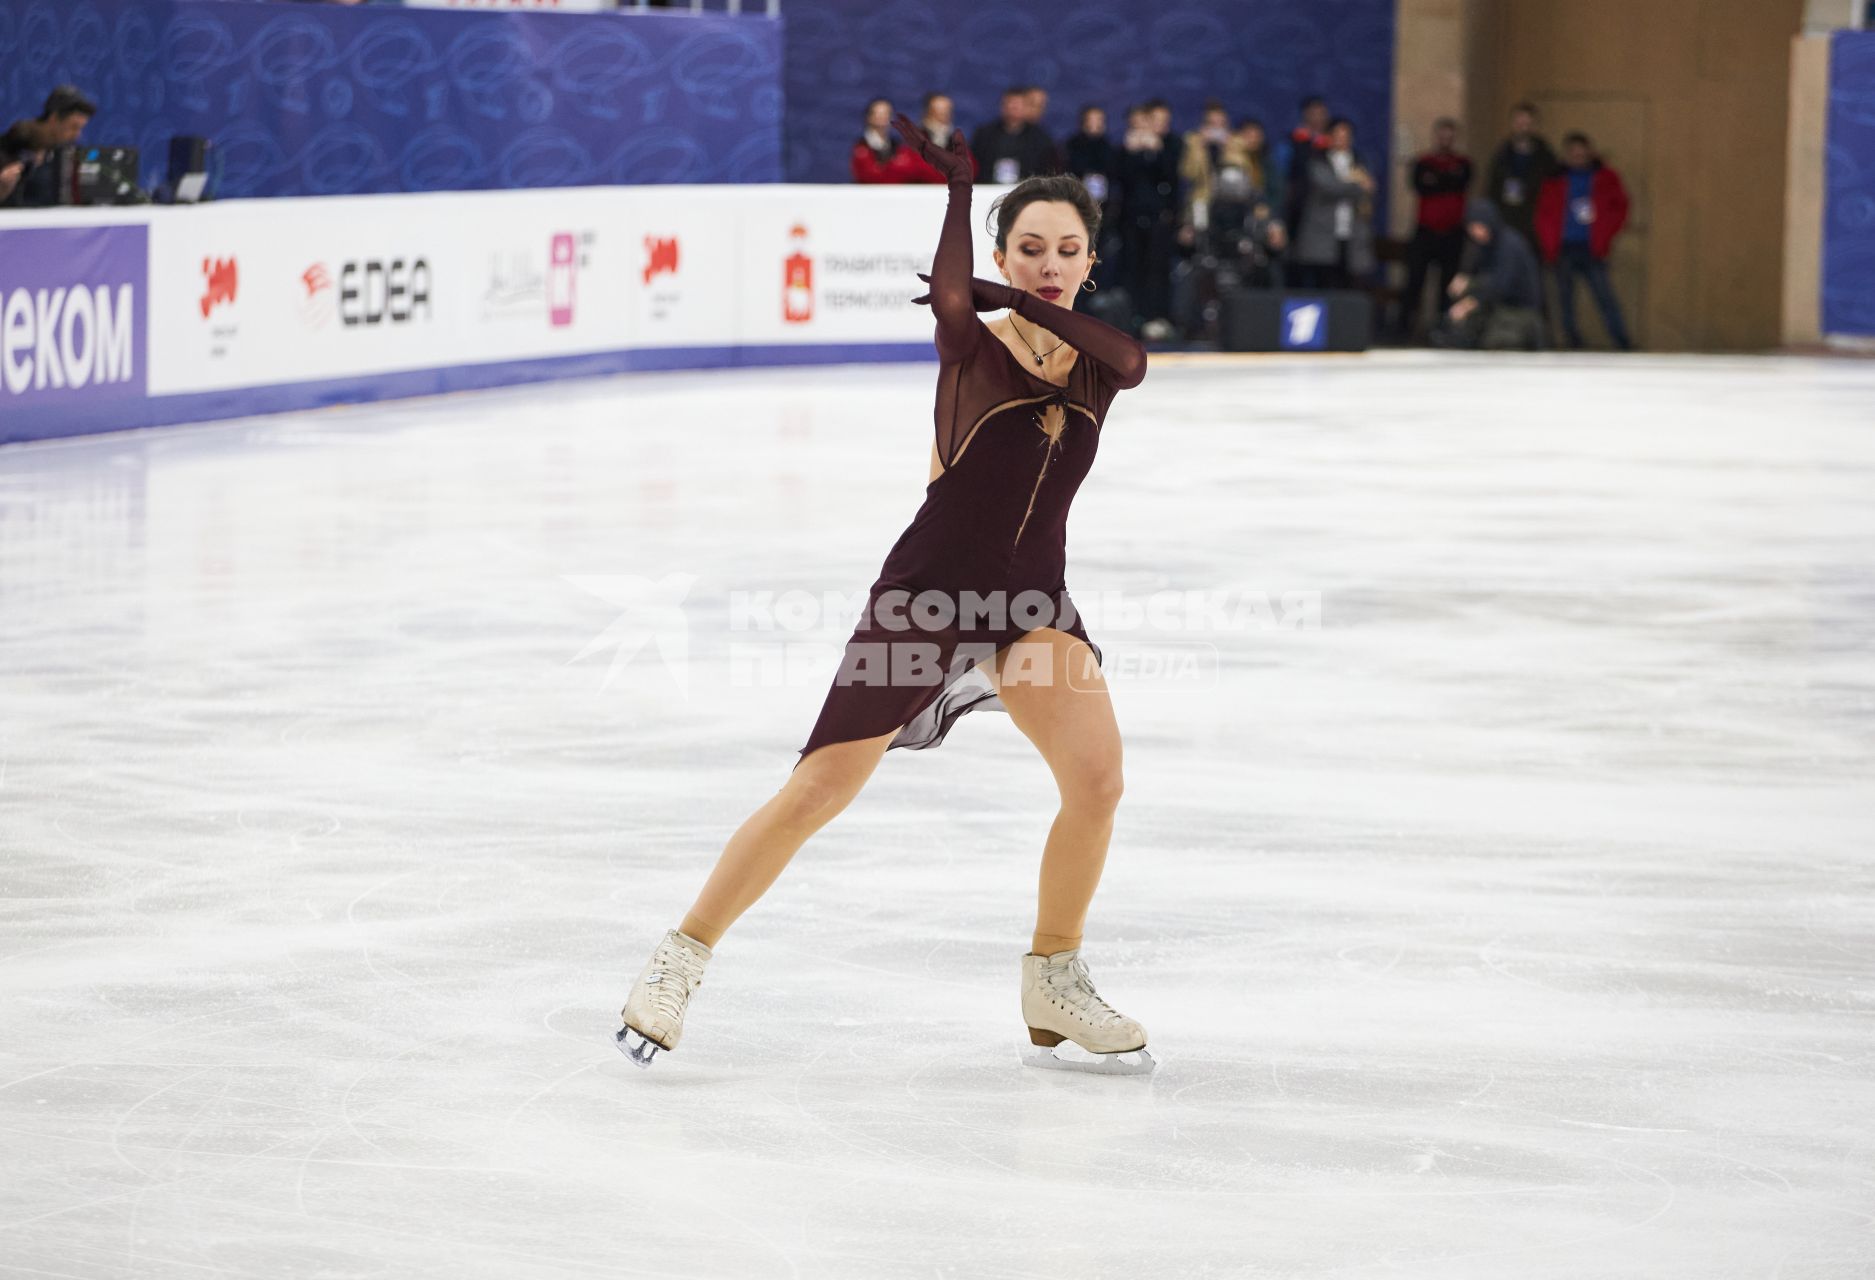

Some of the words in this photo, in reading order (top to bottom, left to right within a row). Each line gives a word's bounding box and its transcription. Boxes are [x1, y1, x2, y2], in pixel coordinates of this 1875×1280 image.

[341, 258, 432, 326] EDEA
[1287, 303, 1321, 345] 1
[0, 282, 133, 395] еком
